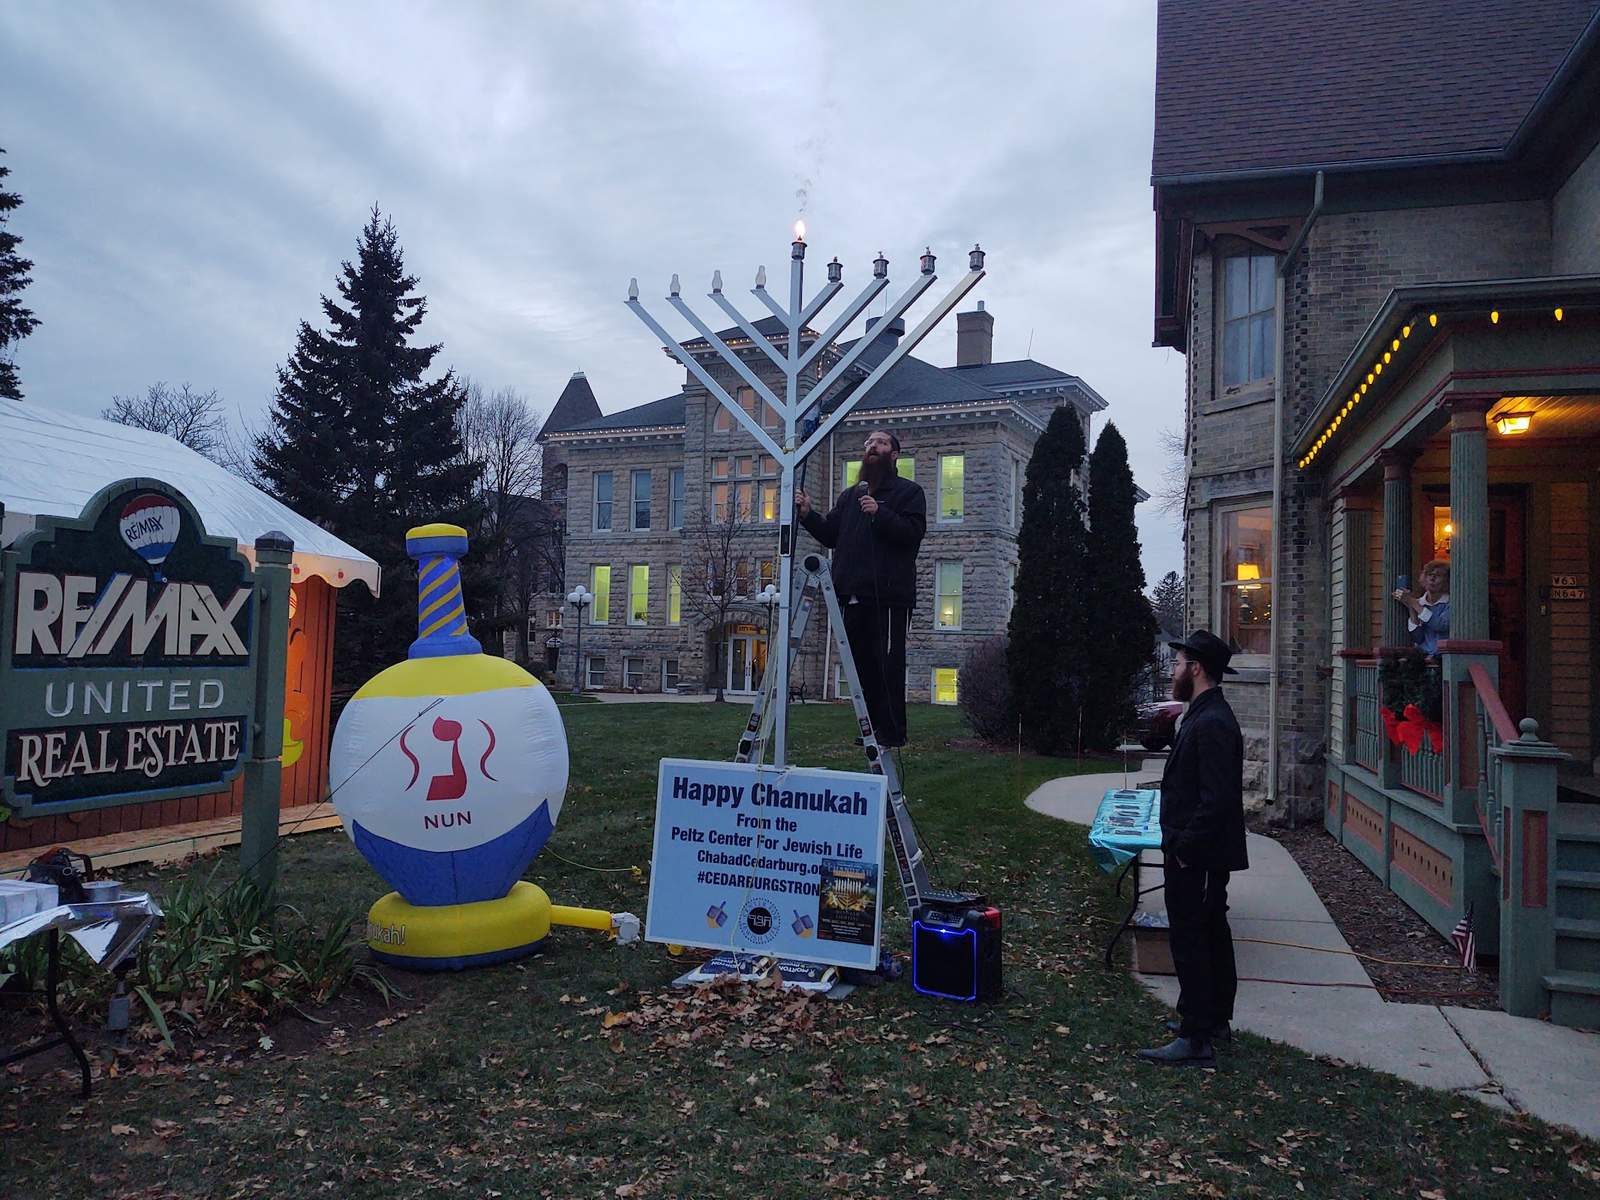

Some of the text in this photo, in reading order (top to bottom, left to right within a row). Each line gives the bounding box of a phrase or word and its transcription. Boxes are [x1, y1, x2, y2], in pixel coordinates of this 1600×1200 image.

[125, 515, 163, 542] RE/MAX
[15, 571, 253, 659] RE/MAX
[45, 679, 225, 718] UNITED
[16, 721, 240, 788] REAL ESTATE
[672, 776, 868, 816] Happy Chanukah
[423, 811, 473, 830] NUN
[736, 813, 798, 833] From the
[671, 826, 864, 860] Peltz Center For Jewish Life
